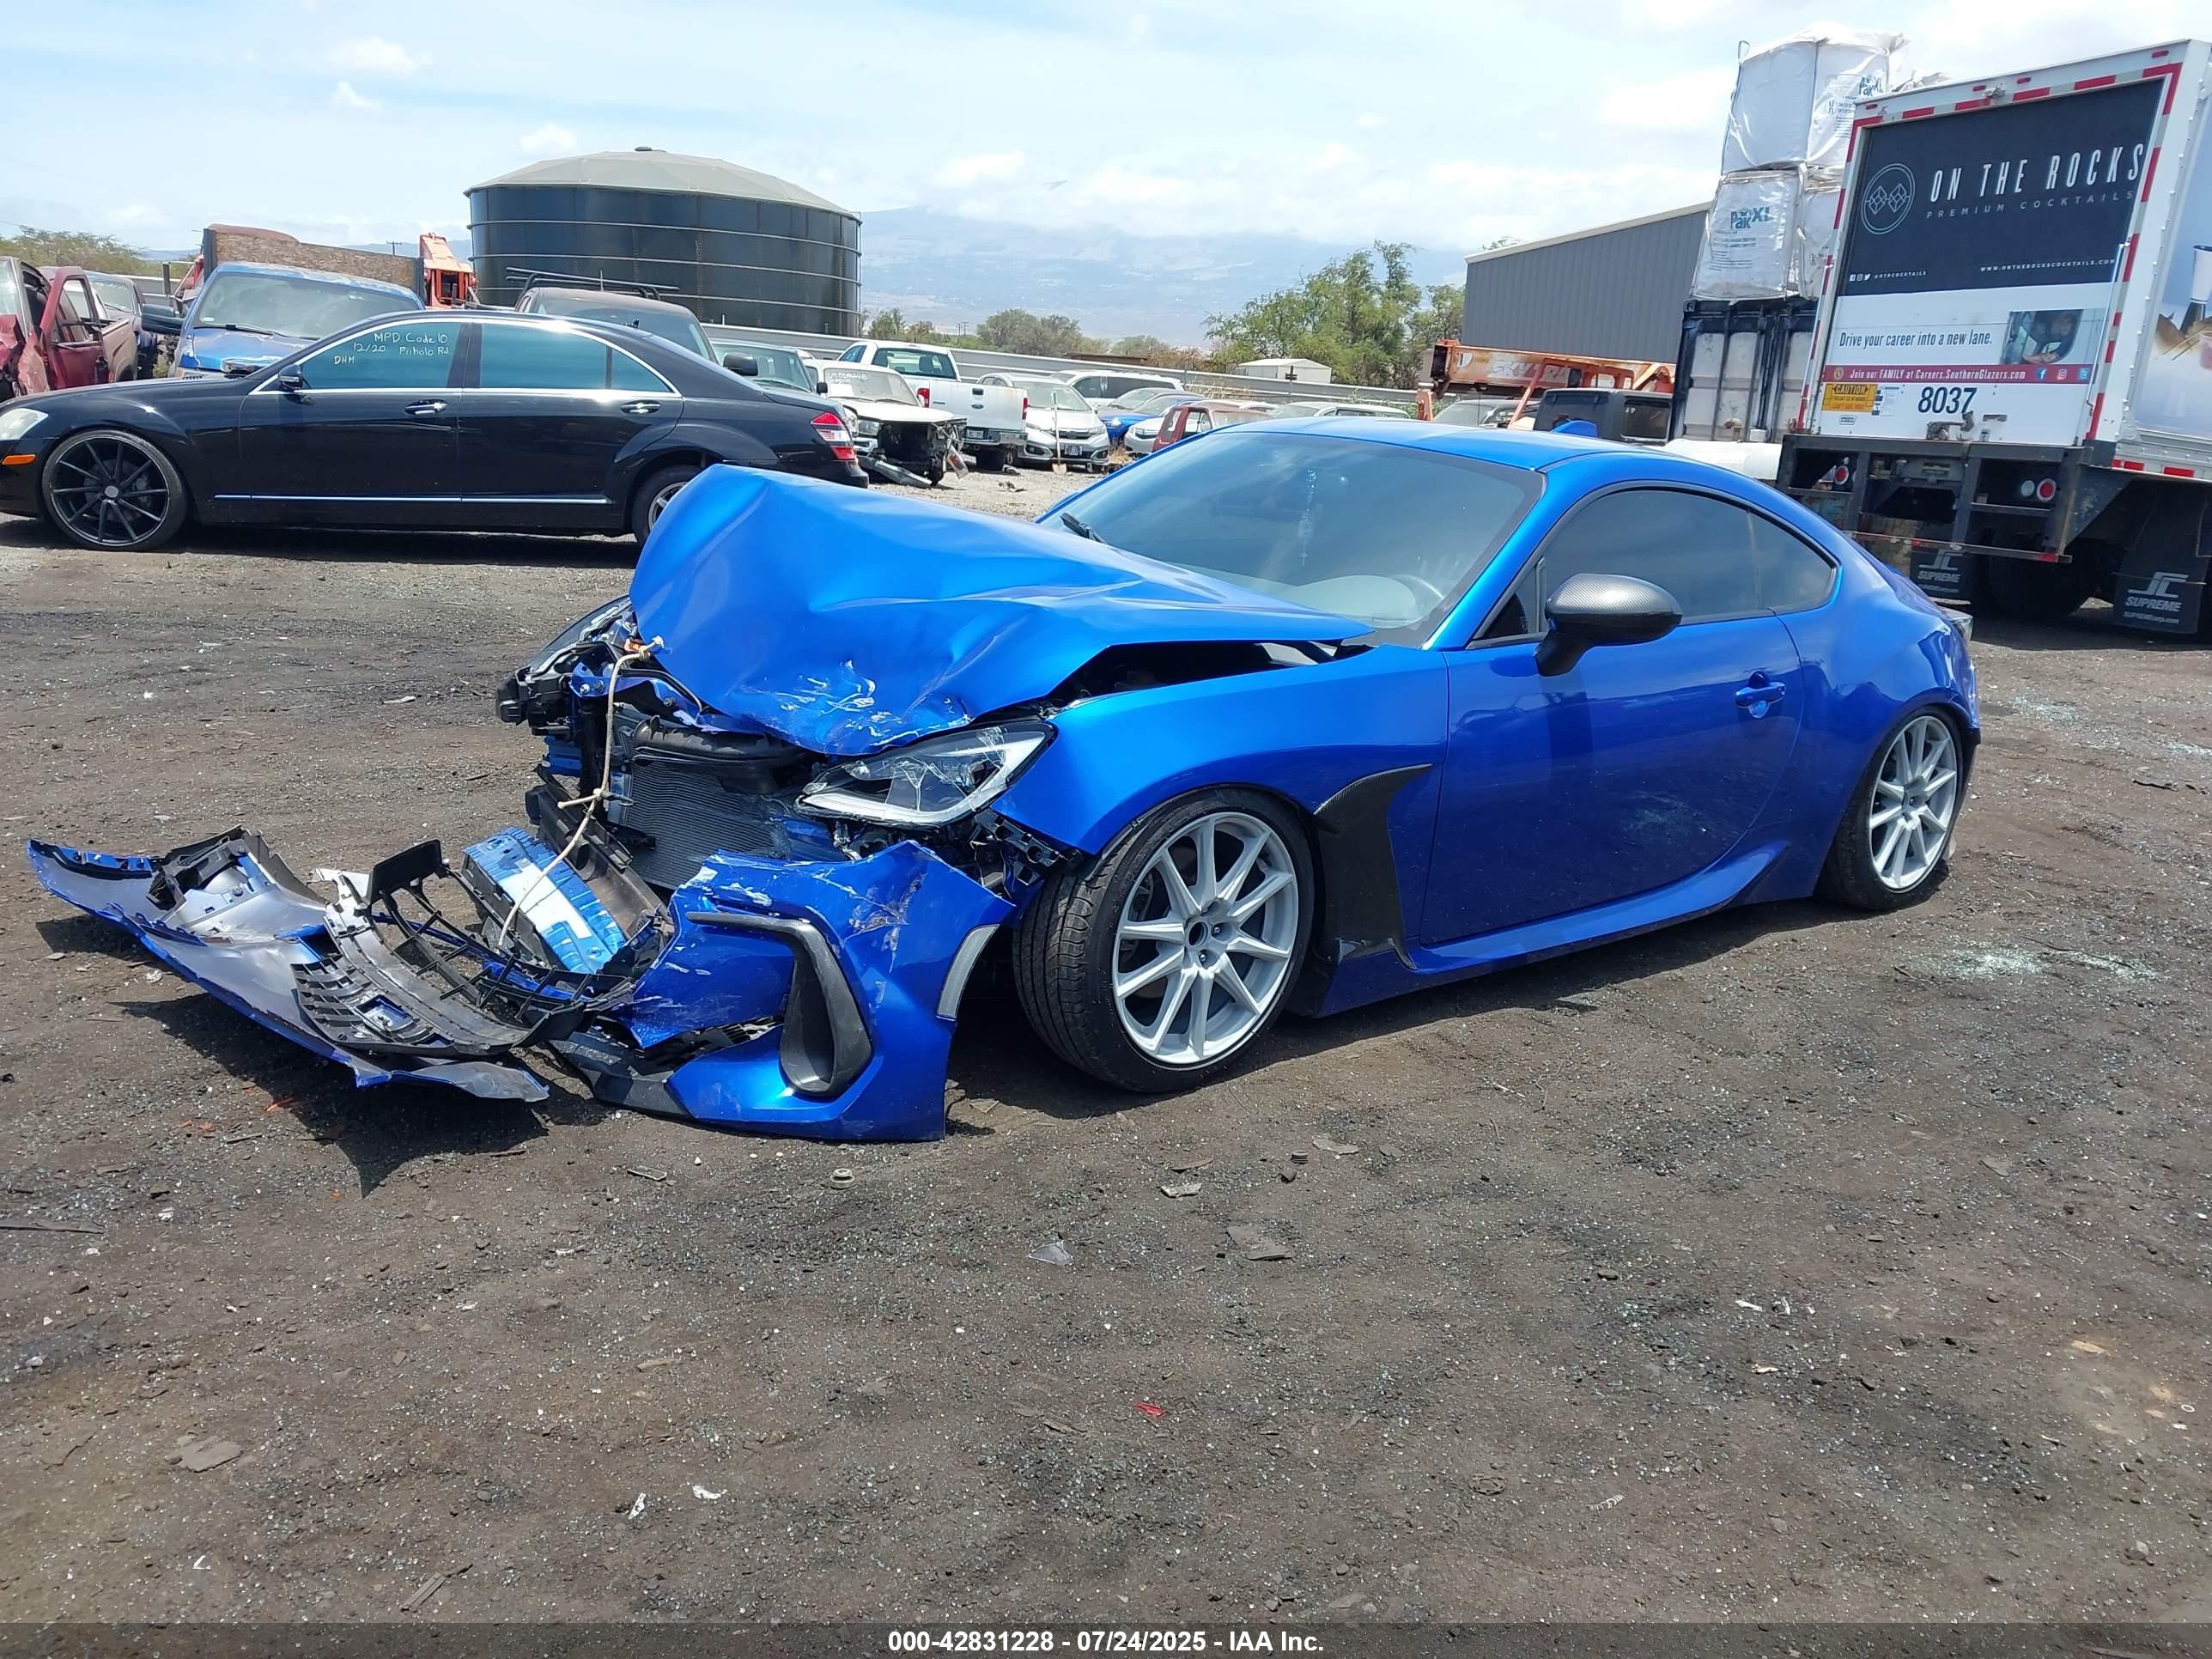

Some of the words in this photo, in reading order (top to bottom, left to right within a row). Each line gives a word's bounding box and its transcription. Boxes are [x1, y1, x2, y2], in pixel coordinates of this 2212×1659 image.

[1930, 167, 1962, 203] ON
[1980, 159, 2028, 198] THE
[2045, 143, 2144, 190] ROCKS
[1926, 204, 2005, 219] PREMIUM
[2020, 191, 2134, 210] COCKTAILS
[374, 331, 400, 343] MPD
[405, 332, 435, 343] Code
[1839, 331, 1863, 347] Drive
[1863, 334, 1884, 350] your
[1886, 334, 1915, 347] career
[1917, 331, 1936, 346] into
[1938, 334, 1945, 345] a
[1947, 333, 1967, 345] new
[1969, 329, 1992, 345] lane.
[353, 342, 386, 352] 12/20
[1850, 368, 1865, 380] Join
[1866, 370, 1878, 380] our
[1879, 368, 1904, 380] FAMILY
[1905, 369, 1914, 380] at
[1915, 368, 2026, 380] Careers.SouthernGlazers.com
[1836, 384, 1868, 395] CAUTION
[1917, 386, 1978, 414] 8037
[1917, 570, 1961, 583] SUPREME
[2124, 595, 2182, 612] SUPREME
